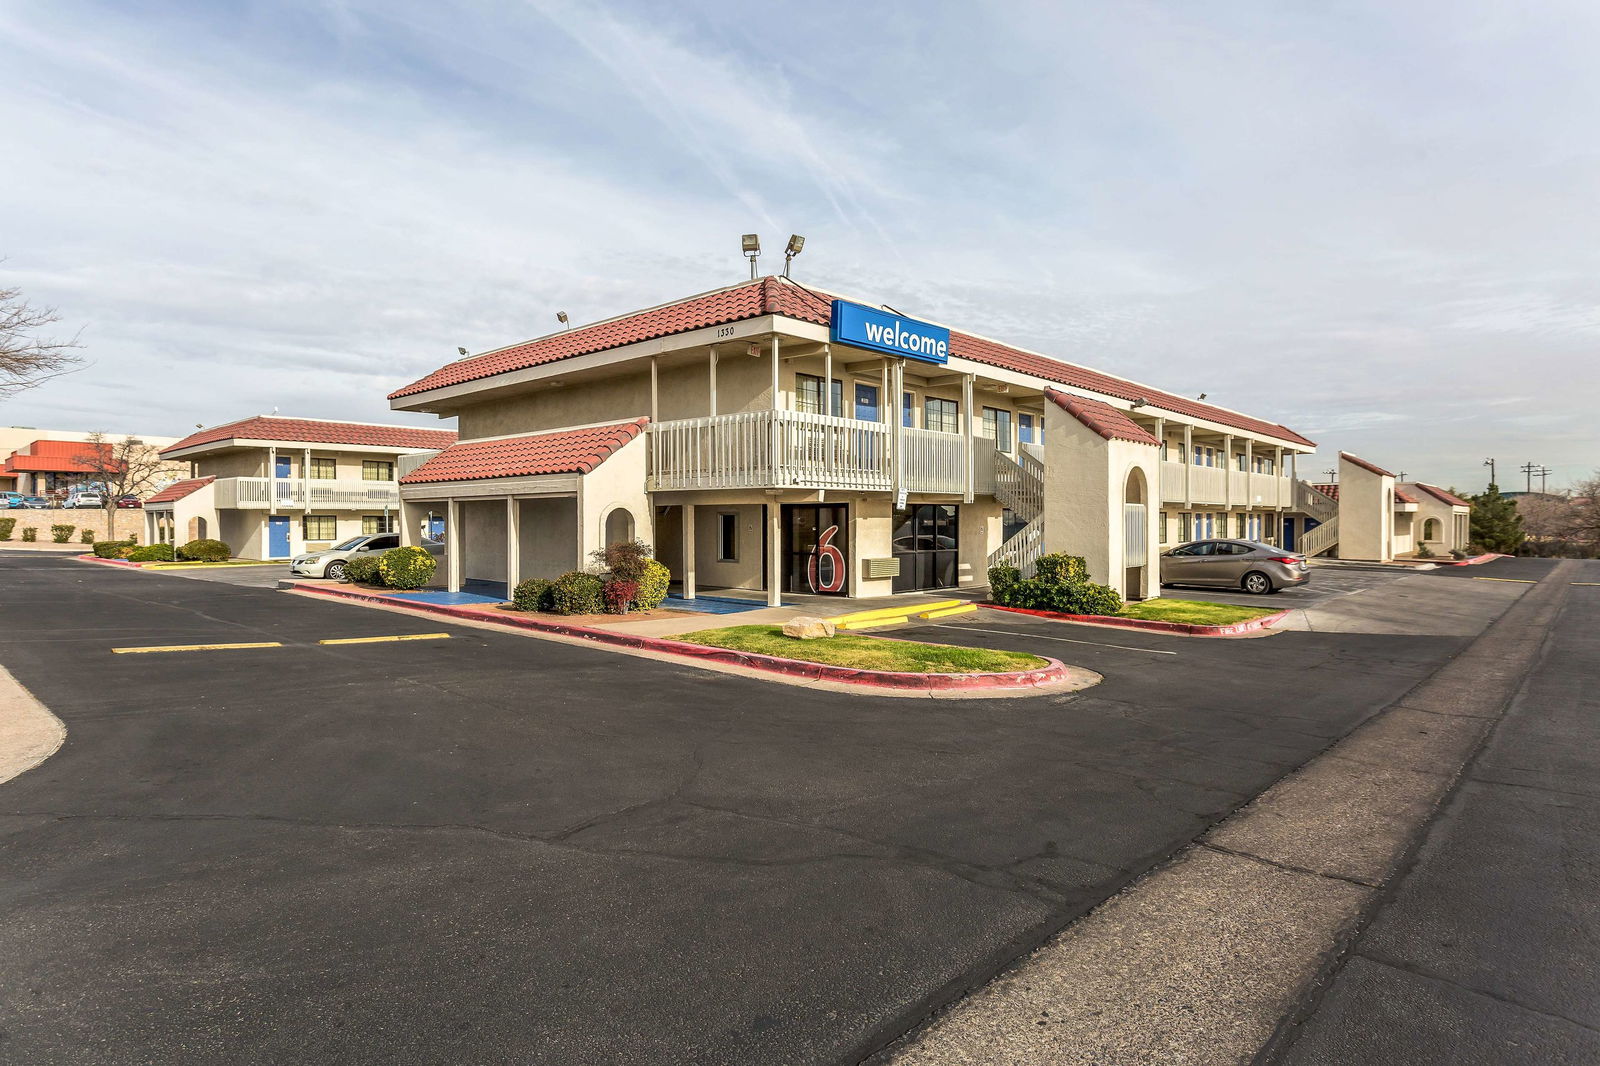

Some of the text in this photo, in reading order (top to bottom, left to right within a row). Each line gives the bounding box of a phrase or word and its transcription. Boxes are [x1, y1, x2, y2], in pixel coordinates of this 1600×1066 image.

[717, 326, 735, 338] 1330
[865, 321, 947, 357] welcome
[808, 525, 846, 594] 6
